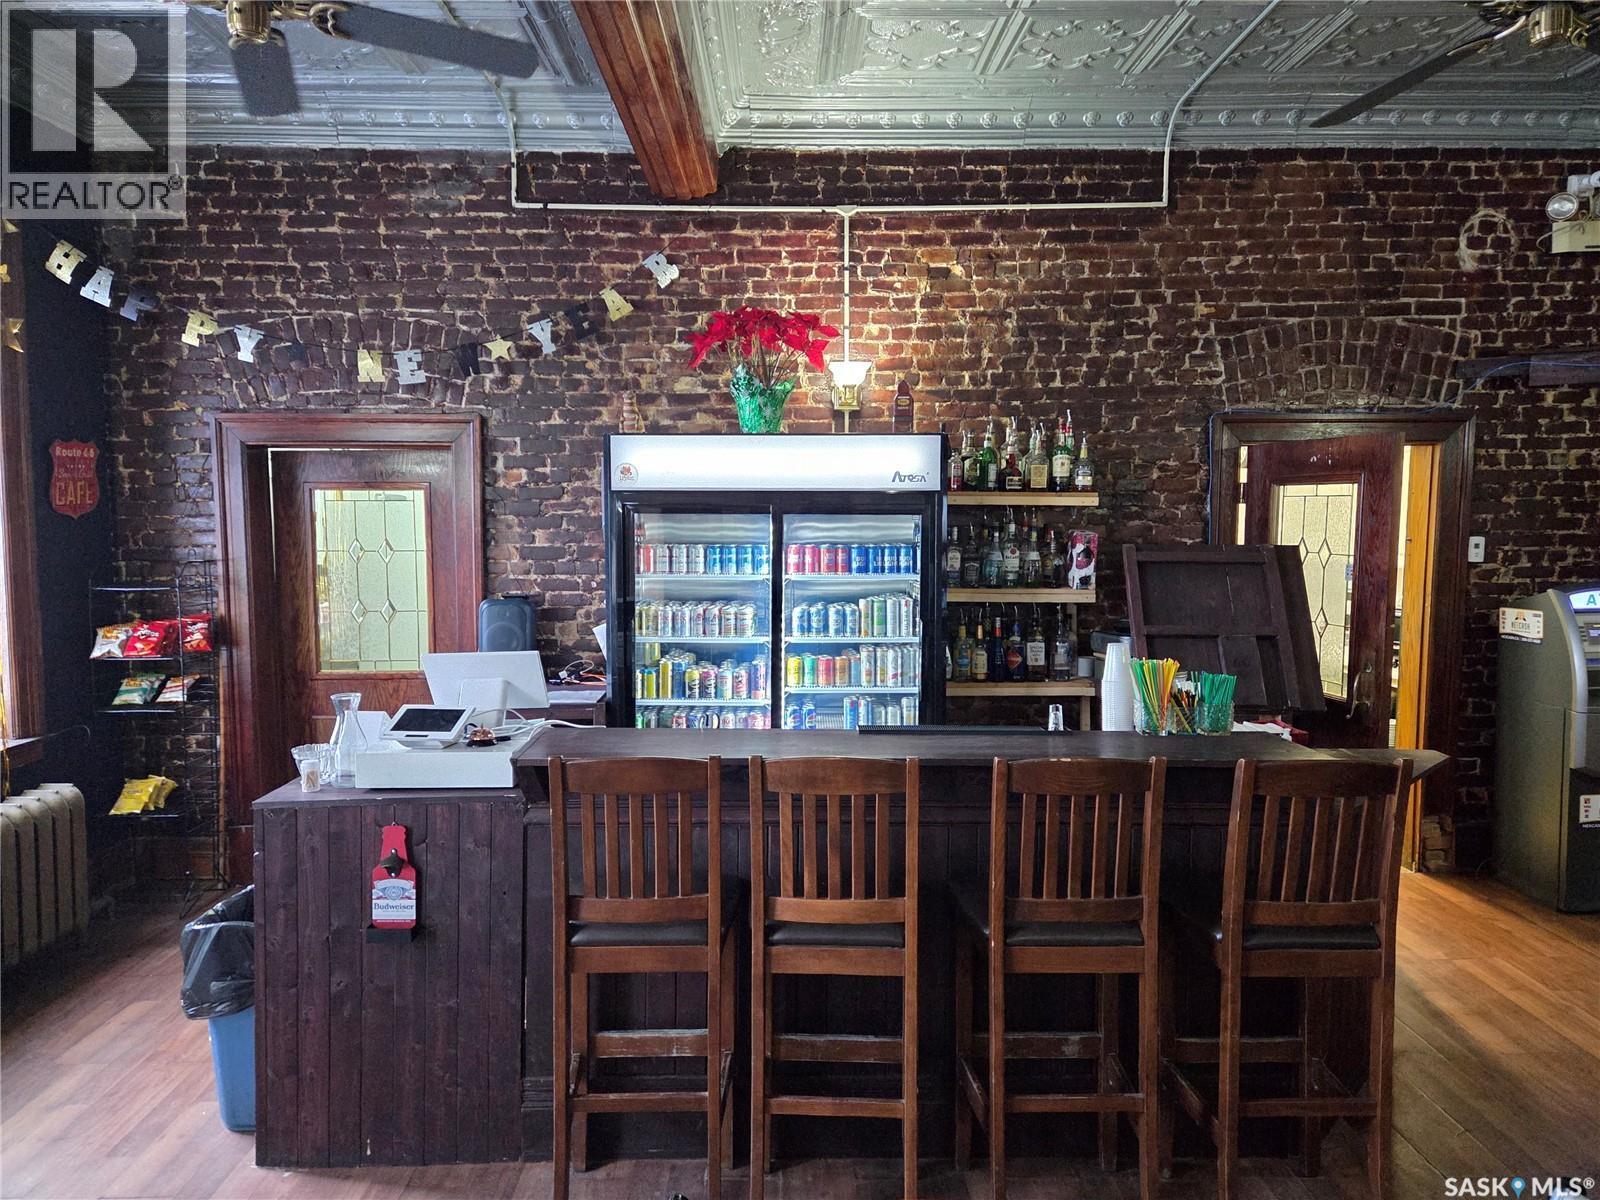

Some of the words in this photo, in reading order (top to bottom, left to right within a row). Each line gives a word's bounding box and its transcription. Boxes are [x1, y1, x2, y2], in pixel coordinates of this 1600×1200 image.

[45, 239, 265, 363] HAPPY
[357, 342, 481, 385] NEW
[527, 252, 680, 355] YEAR
[55, 446, 82, 457] Route
[373, 902, 415, 911] Budweiser
